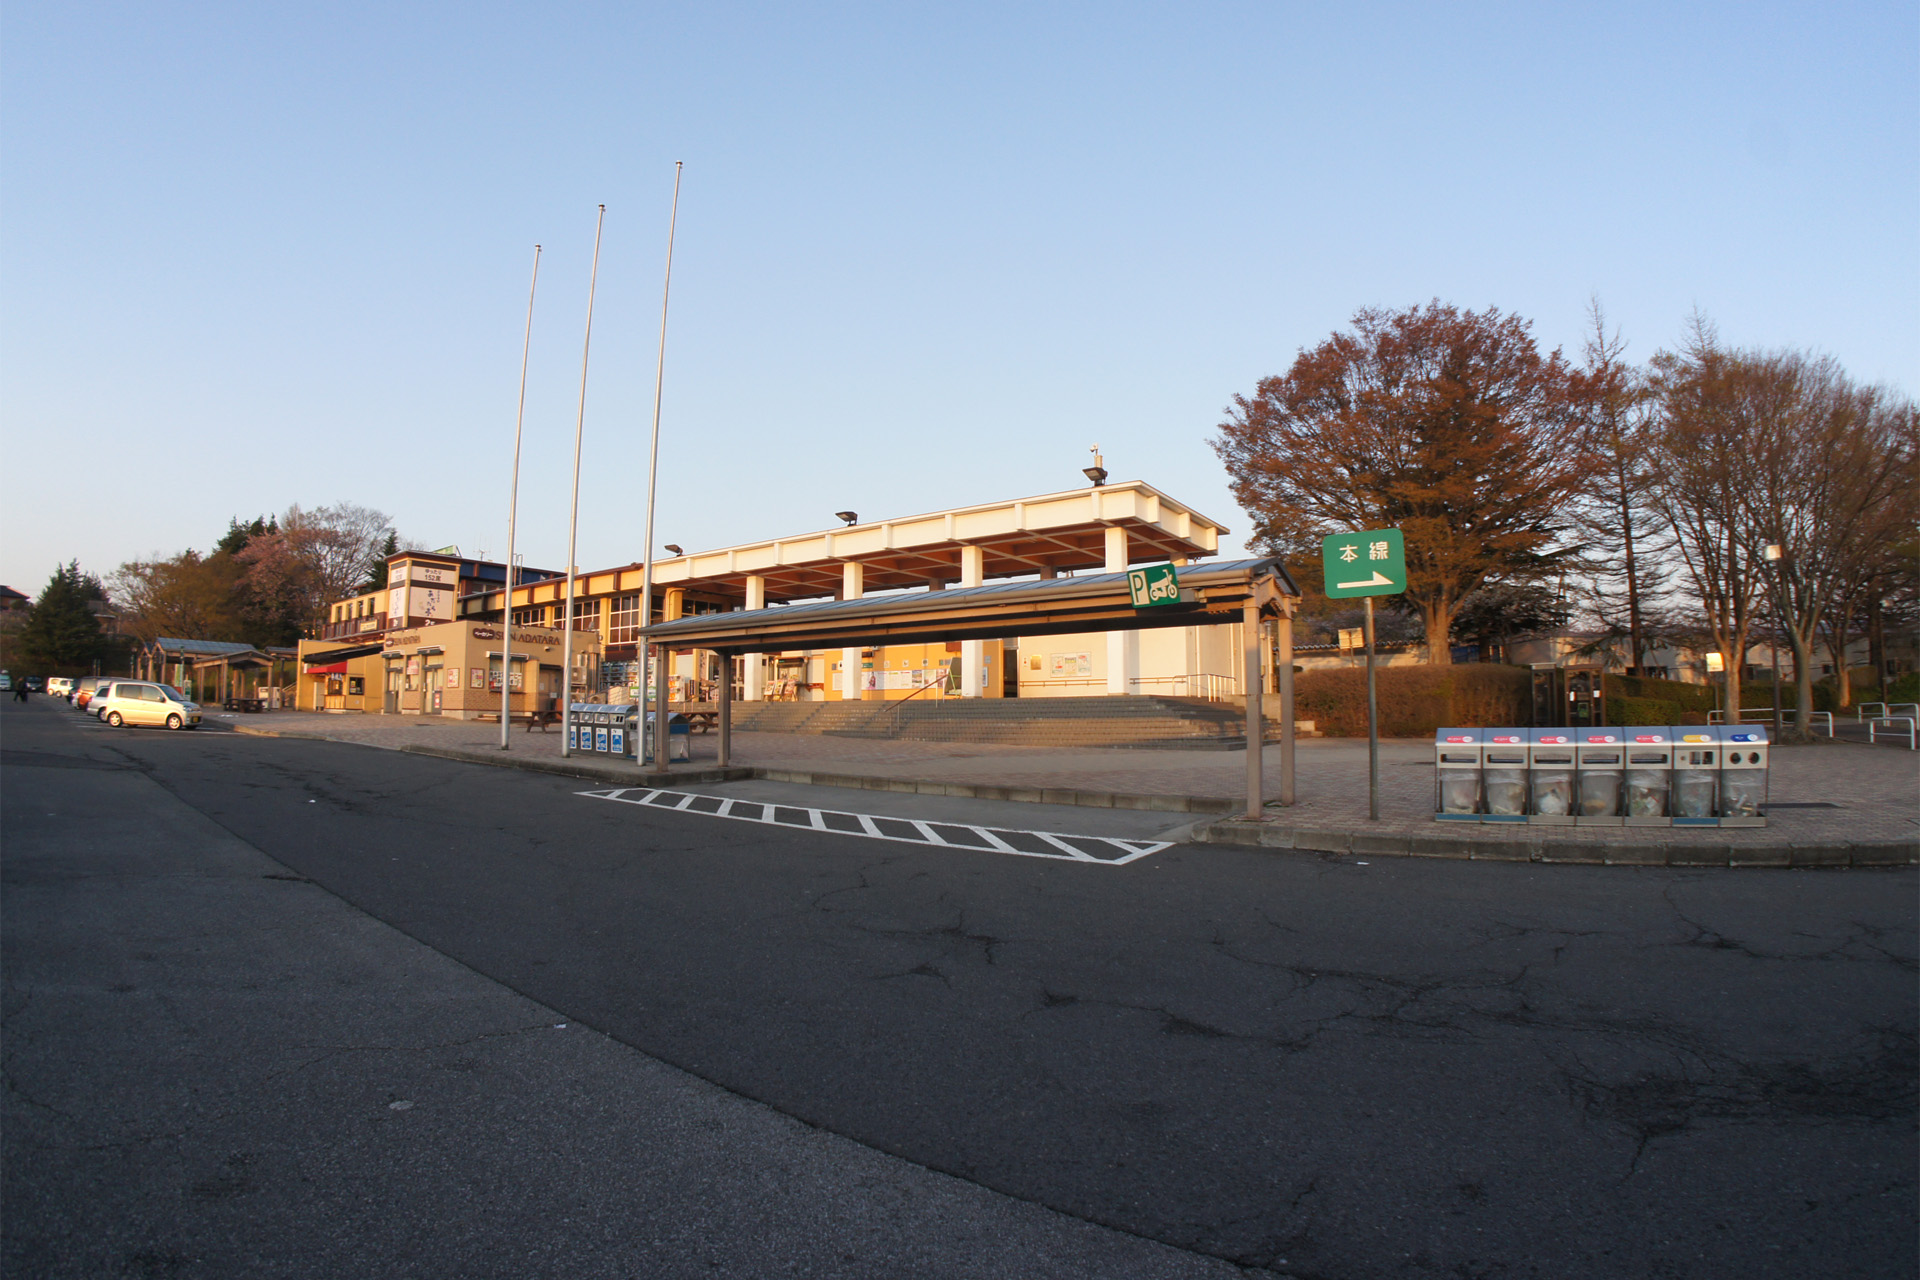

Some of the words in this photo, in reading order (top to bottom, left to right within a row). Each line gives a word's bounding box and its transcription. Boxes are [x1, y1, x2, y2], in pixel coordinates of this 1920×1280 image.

[1339, 541, 1389, 563] 本線
[1132, 574, 1144, 603] P
[518, 634, 561, 645] ADATARA
